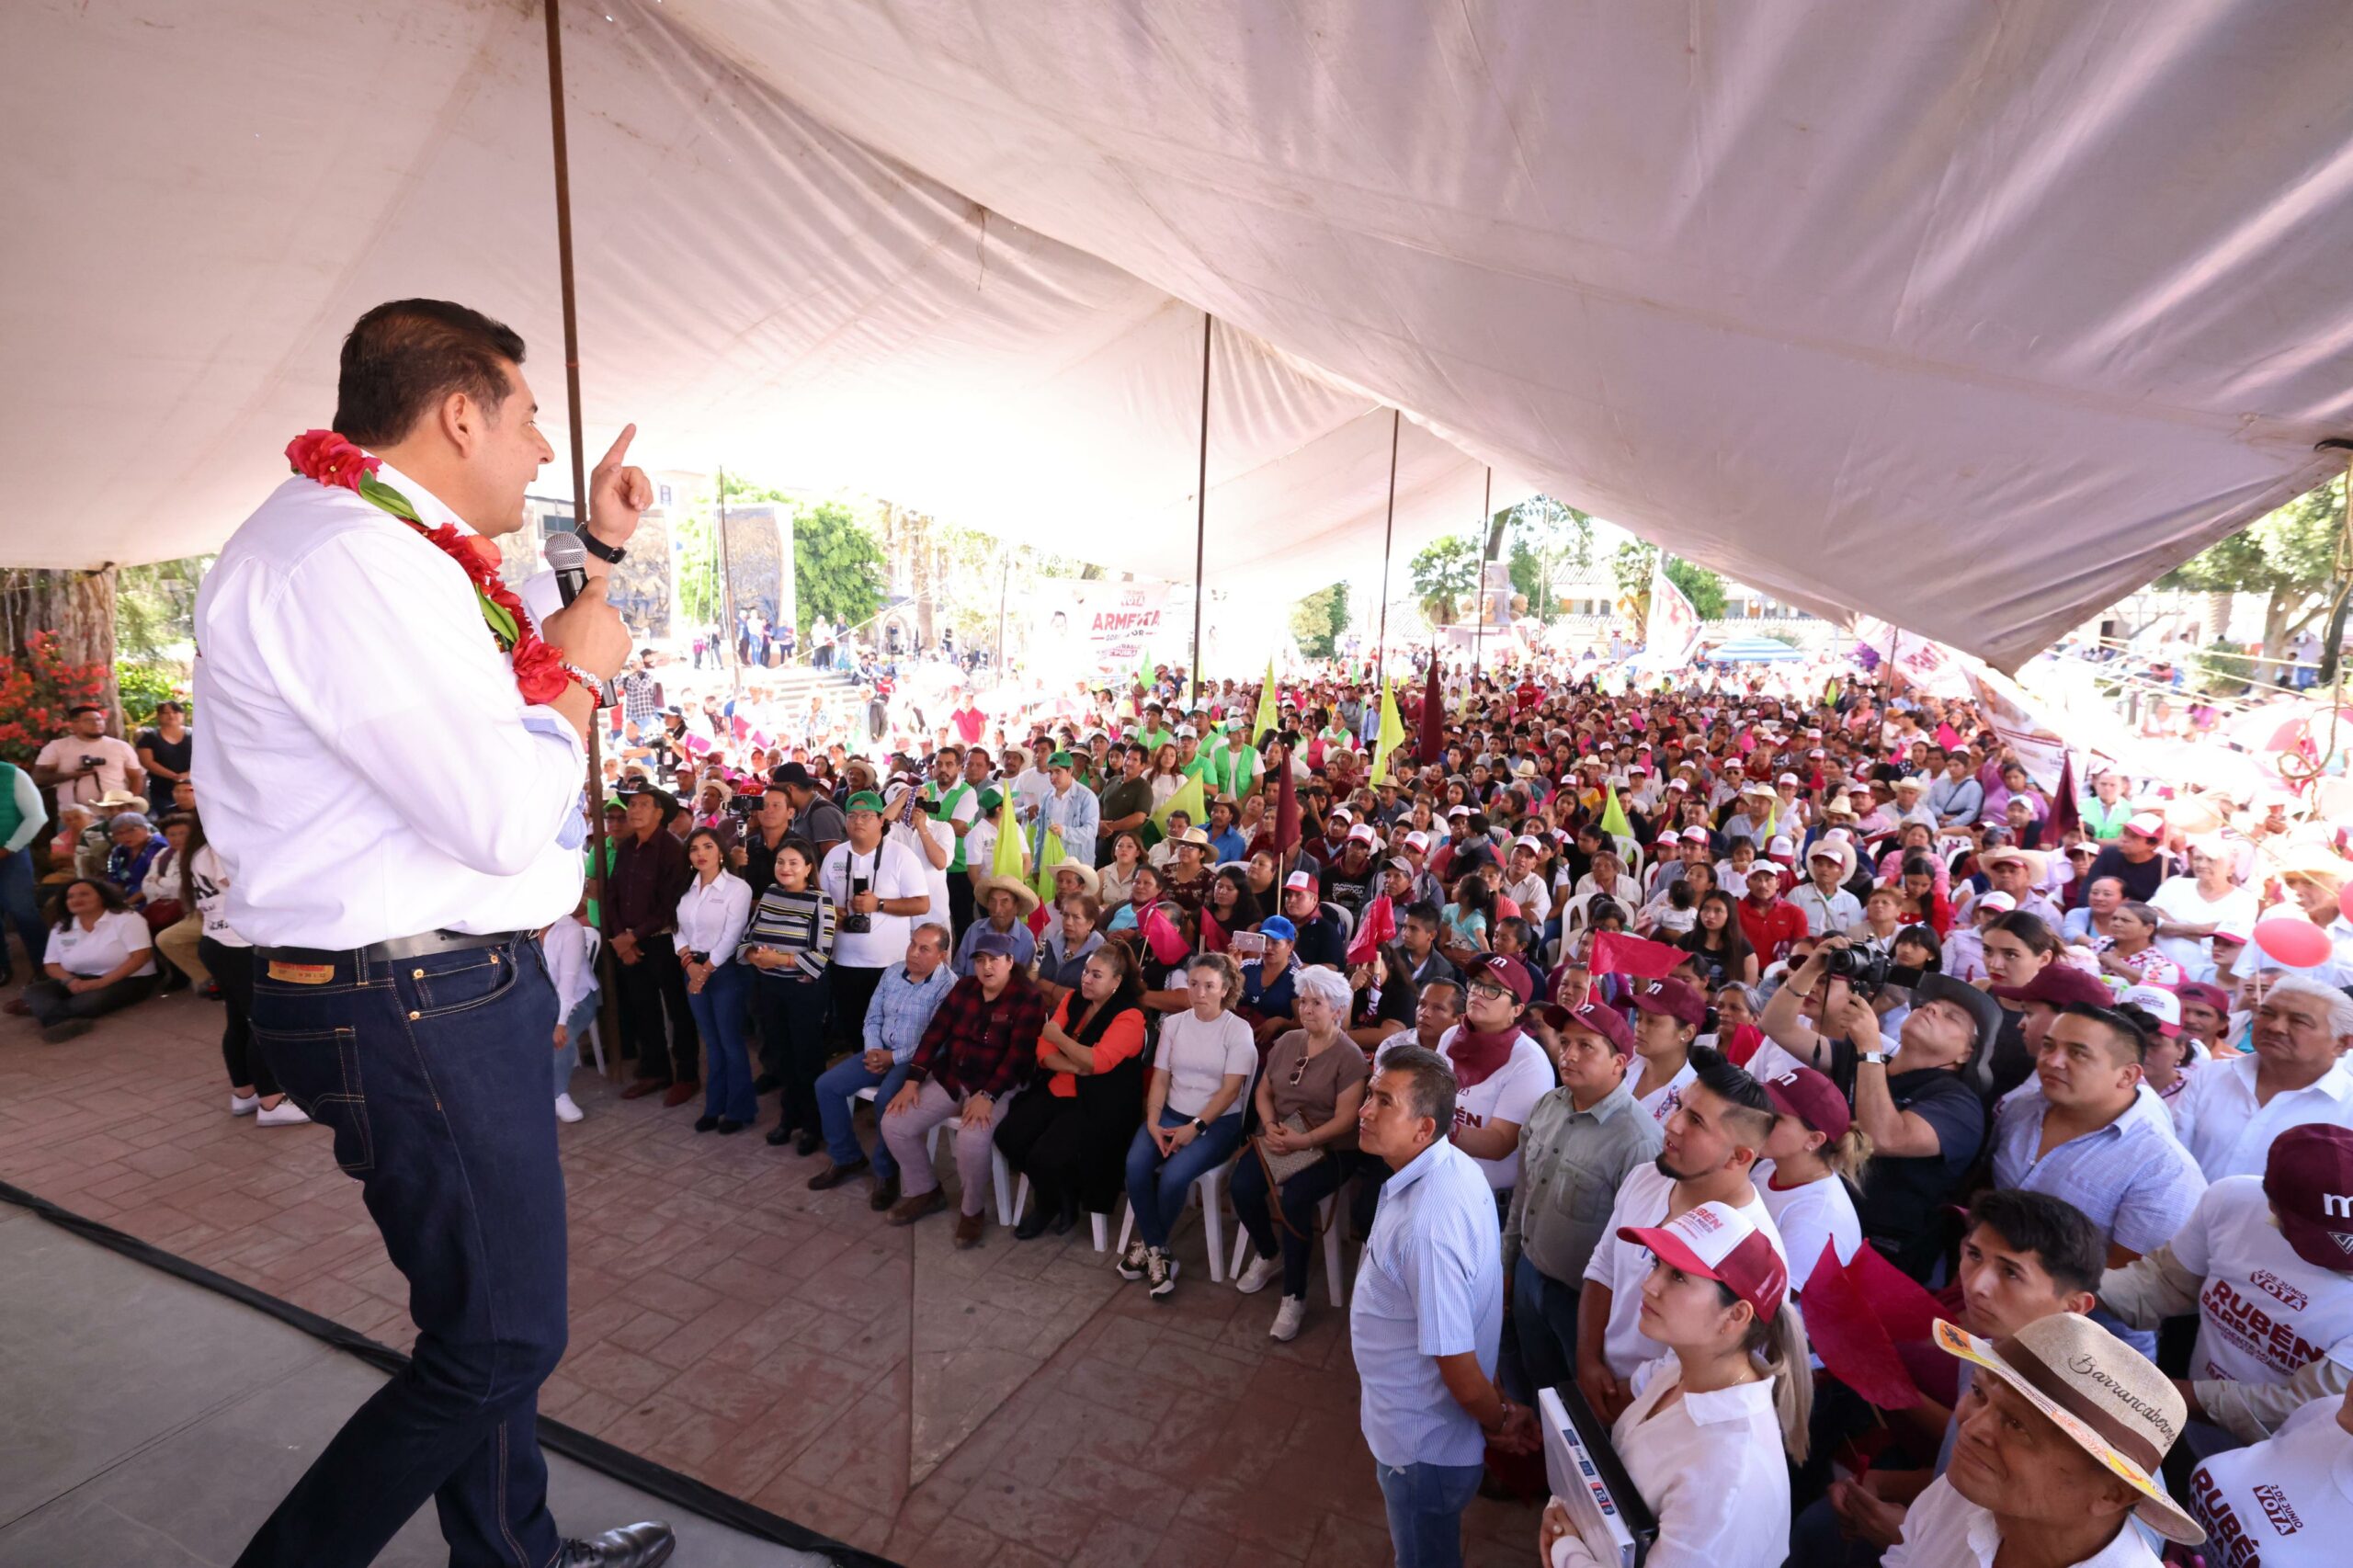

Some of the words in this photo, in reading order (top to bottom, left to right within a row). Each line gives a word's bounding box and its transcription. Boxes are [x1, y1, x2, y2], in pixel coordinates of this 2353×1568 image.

[2251, 1272, 2307, 1312] VOTA
[2266, 1272, 2277, 1282] DE
[2279, 1281, 2308, 1301] JUNIO
[2201, 1290, 2262, 1347] BARBA
[2211, 1279, 2325, 1363] RUBÉN
[2254, 1485, 2296, 1536] VOTA
[2274, 1491, 2288, 1503] DE
[2282, 1502, 2303, 1529] JUNIO
